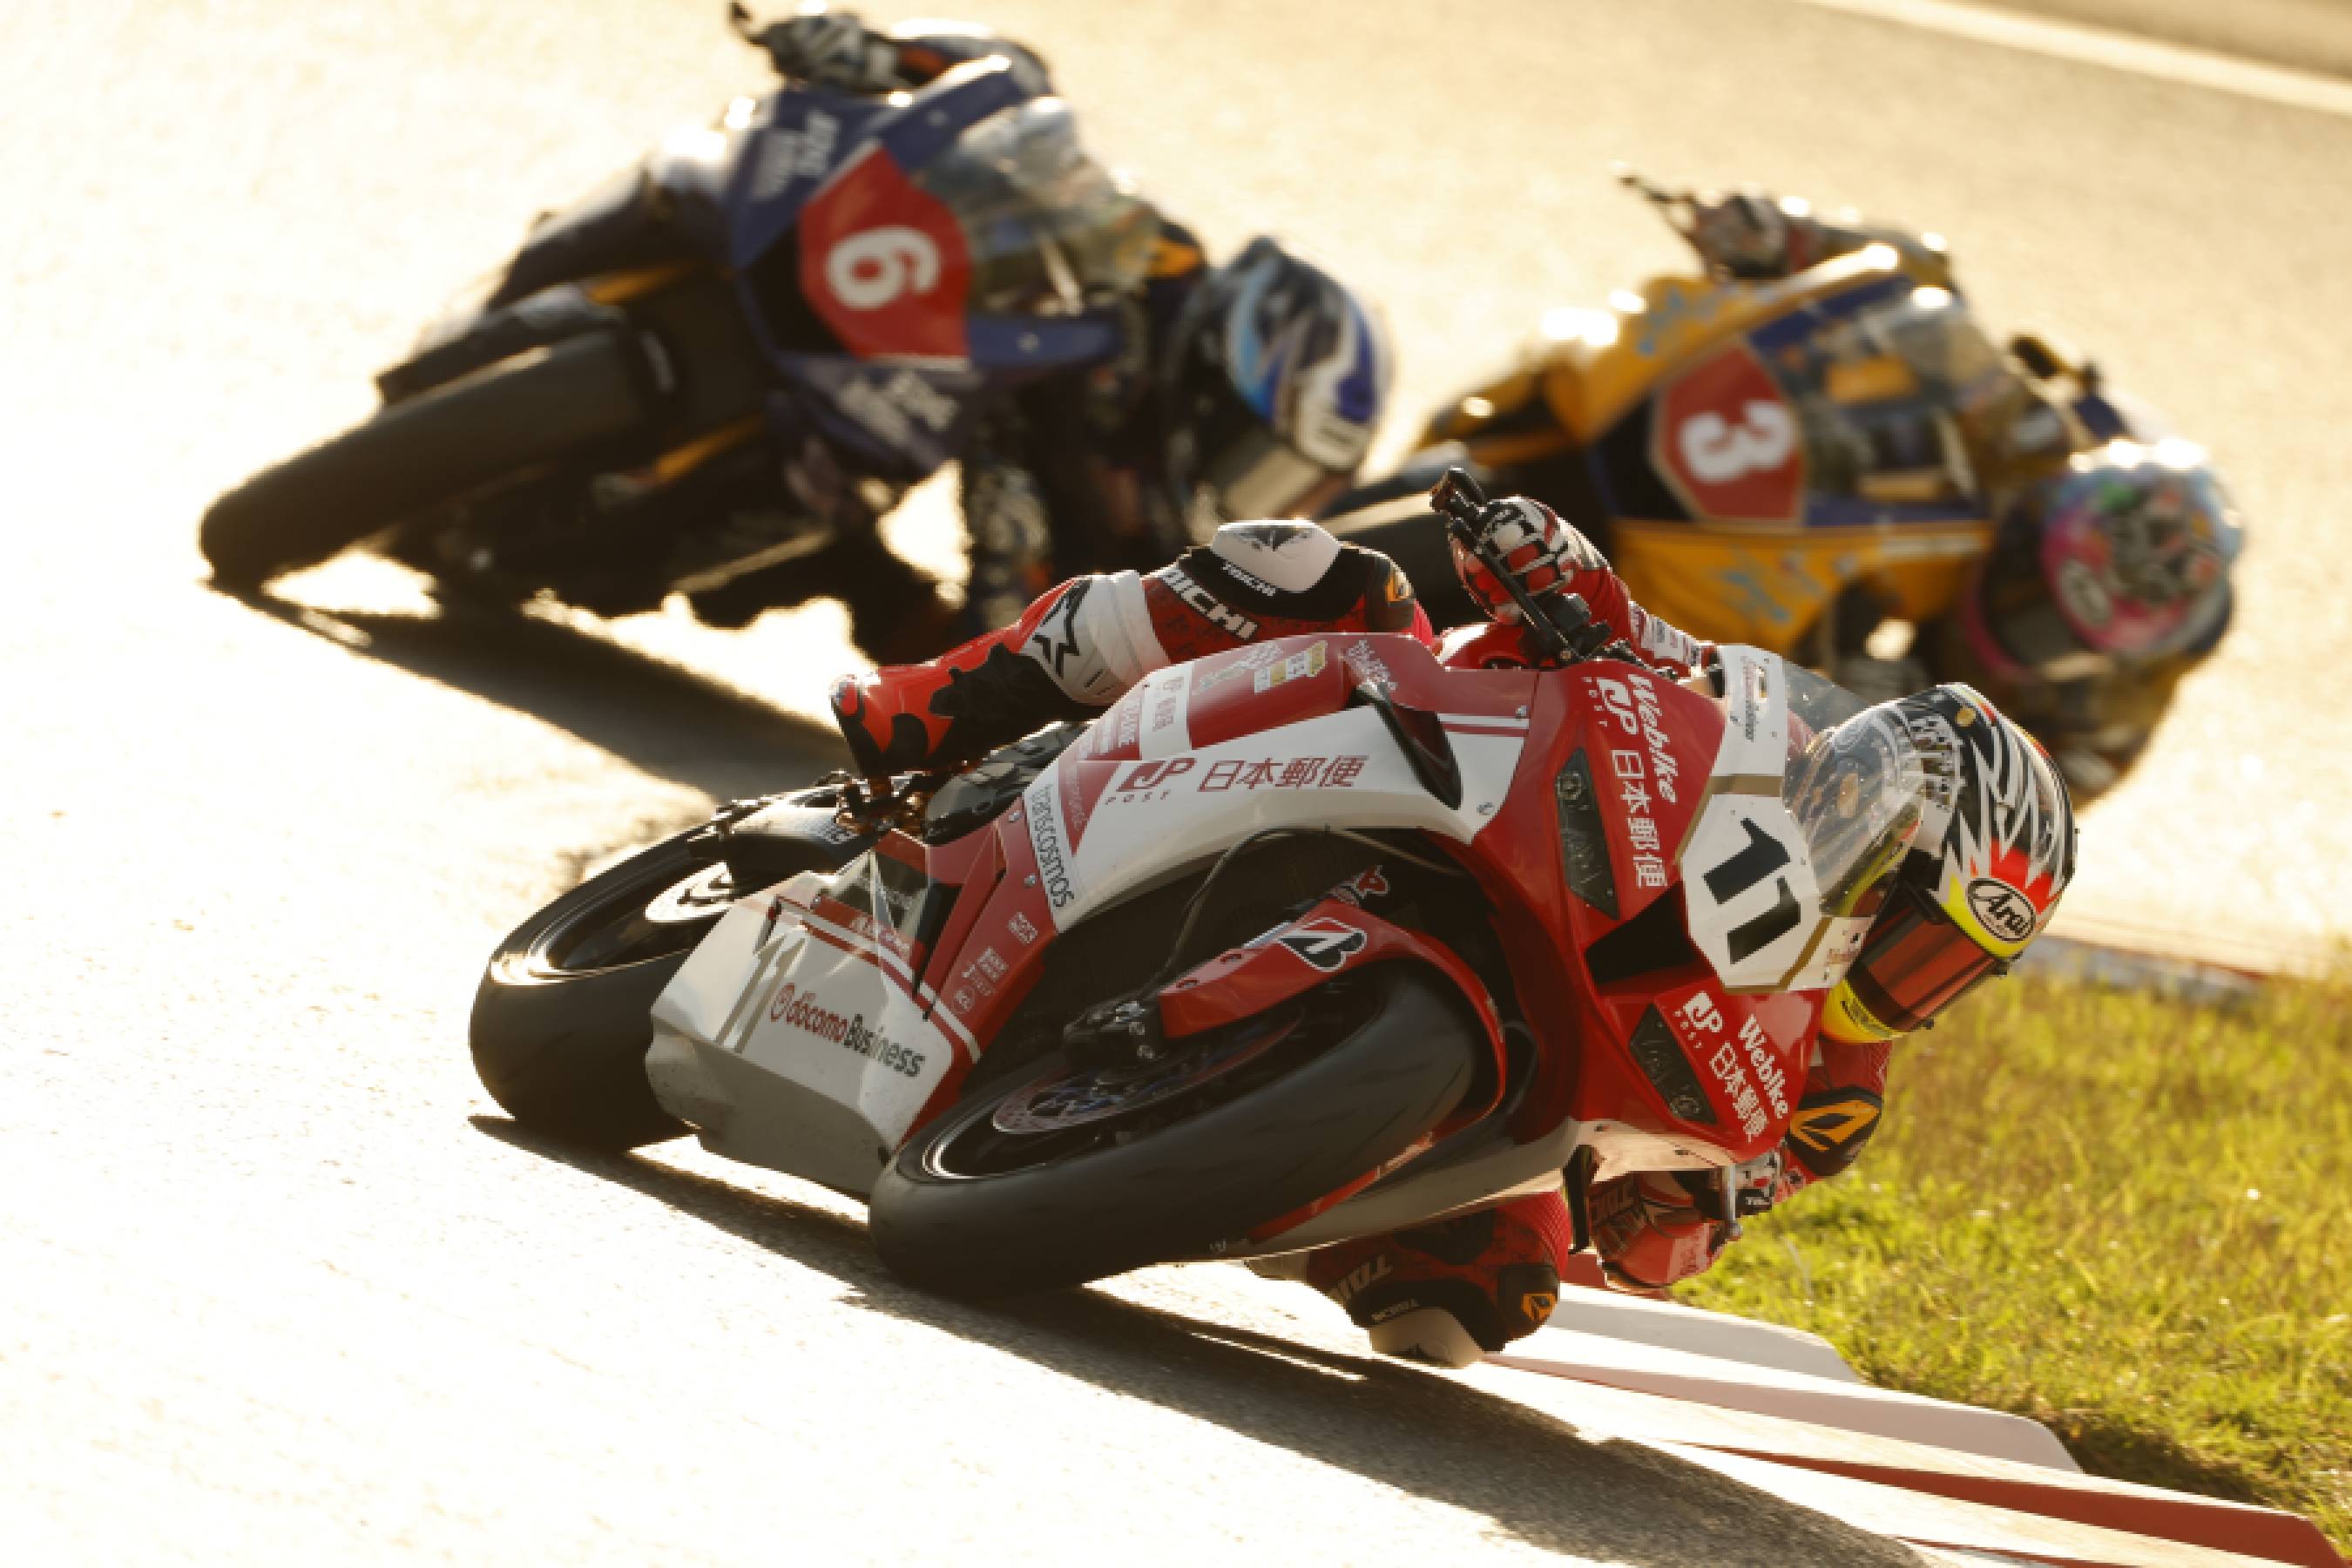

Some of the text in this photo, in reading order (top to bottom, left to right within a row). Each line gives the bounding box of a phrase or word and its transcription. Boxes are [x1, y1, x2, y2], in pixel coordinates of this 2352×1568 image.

[826, 226, 942, 310] 6
[1678, 399, 1794, 483] 3
[1197, 754, 1370, 792] 日本郵便
[1627, 673, 1679, 804] Webike
[1031, 783, 1075, 908] transcosmos
[1610, 749, 1667, 889] 日本郵便
[1702, 816, 1801, 966] 11
[1971, 893, 2030, 936] Arai
[1738, 1012, 1789, 1120] Webike
